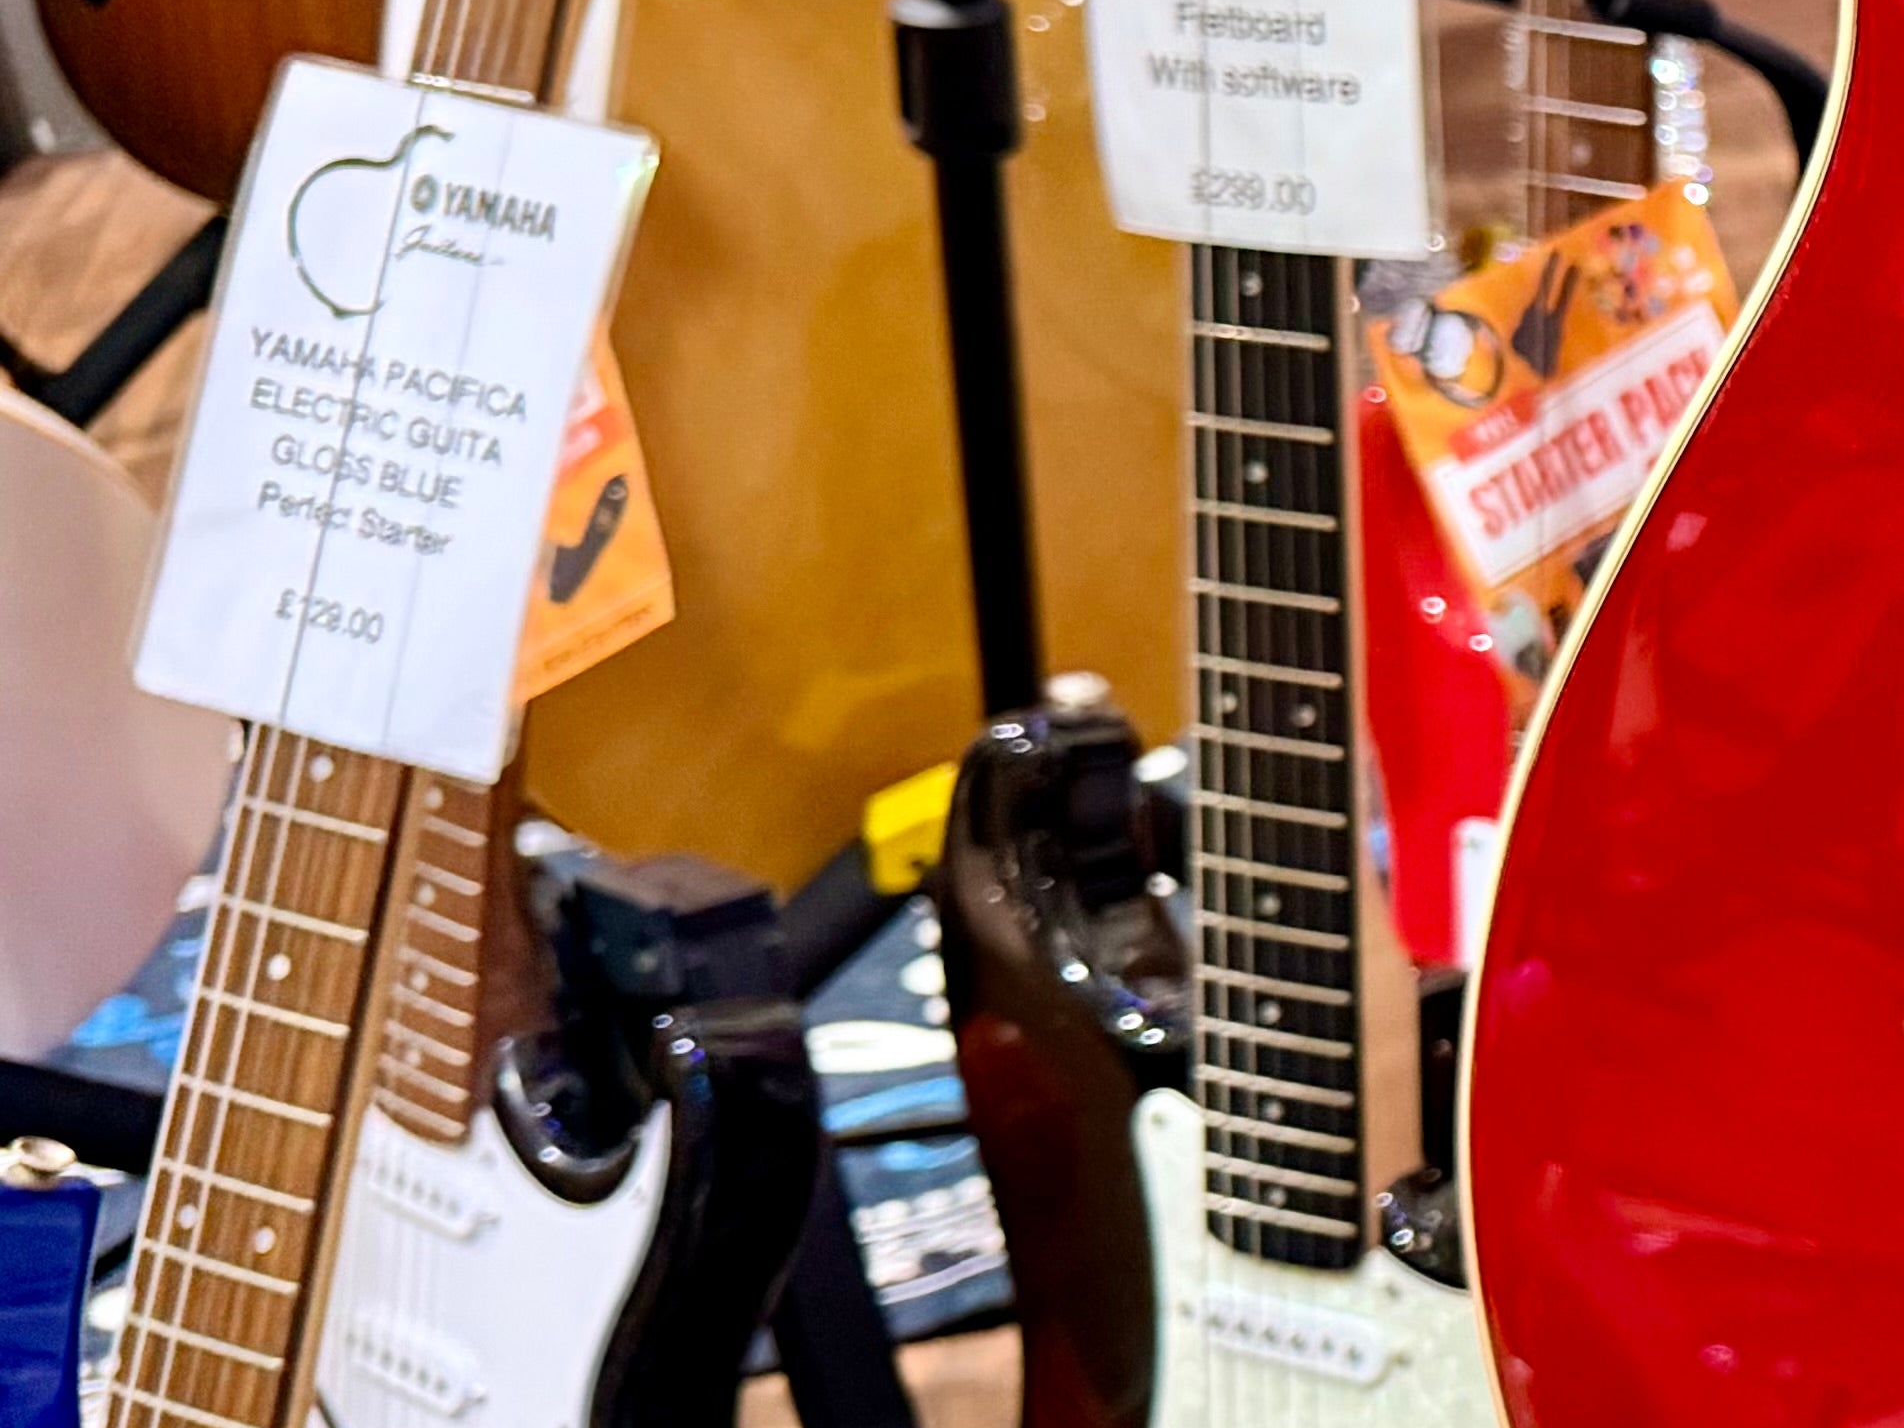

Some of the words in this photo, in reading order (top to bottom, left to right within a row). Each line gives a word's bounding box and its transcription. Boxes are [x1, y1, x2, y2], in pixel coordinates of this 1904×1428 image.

[1174, 0, 1328, 47] Fretboard
[1145, 50, 1215, 94] With
[1222, 61, 1361, 106] software
[442, 180, 558, 243] YAMAHA
[251, 327, 376, 384] YAMAHA
[384, 359, 528, 422] PACIFICA
[250, 376, 399, 442] ELECTRIC
[407, 415, 502, 465] GUITA
[271, 432, 373, 486] GLOSS
[379, 459, 463, 509] BLUE
[1468, 409, 1626, 541] STARTER
[358, 506, 452, 556] Starter
